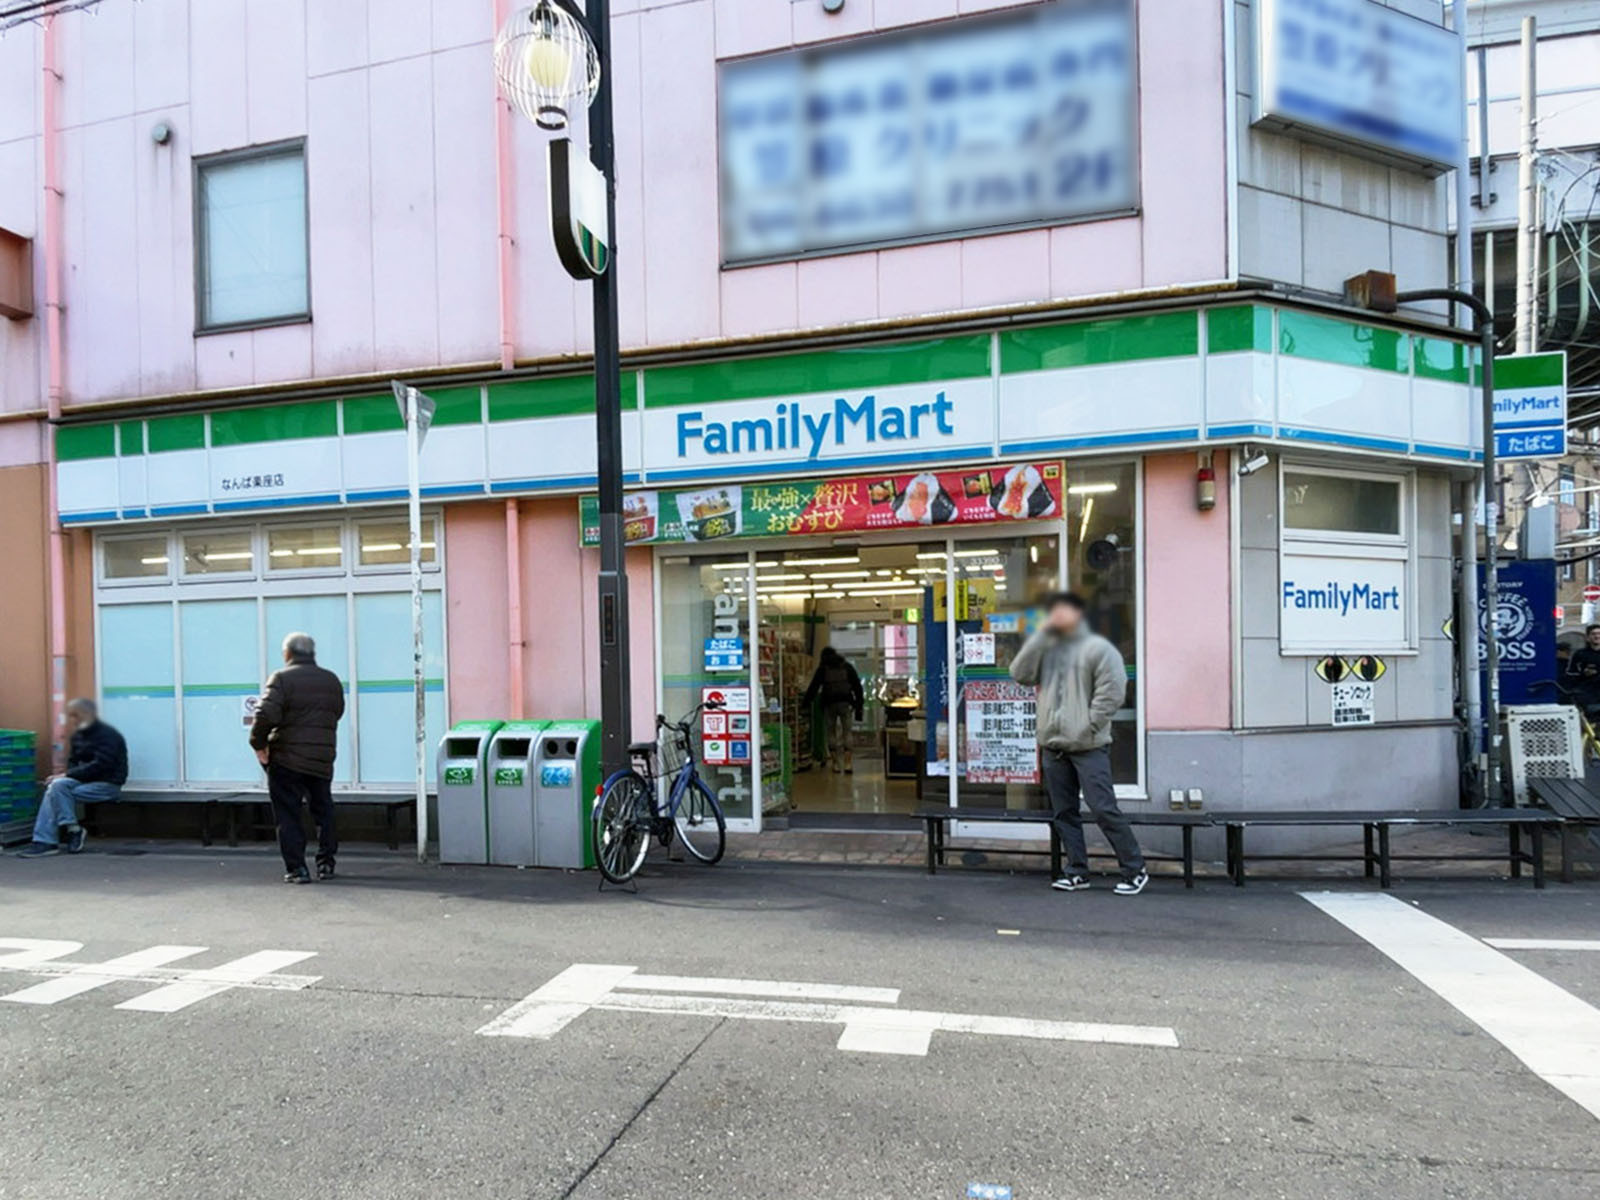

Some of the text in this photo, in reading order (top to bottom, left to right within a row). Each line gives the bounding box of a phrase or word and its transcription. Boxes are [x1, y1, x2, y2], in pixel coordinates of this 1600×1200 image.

[1493, 396, 1560, 415] milyMart
[677, 391, 954, 458] FamilyMart
[1508, 434, 1556, 453] たばこ
[767, 508, 846, 533] おむすび
[1283, 581, 1400, 617] FamilyMart
[1479, 592, 1529, 608] CFFEE
